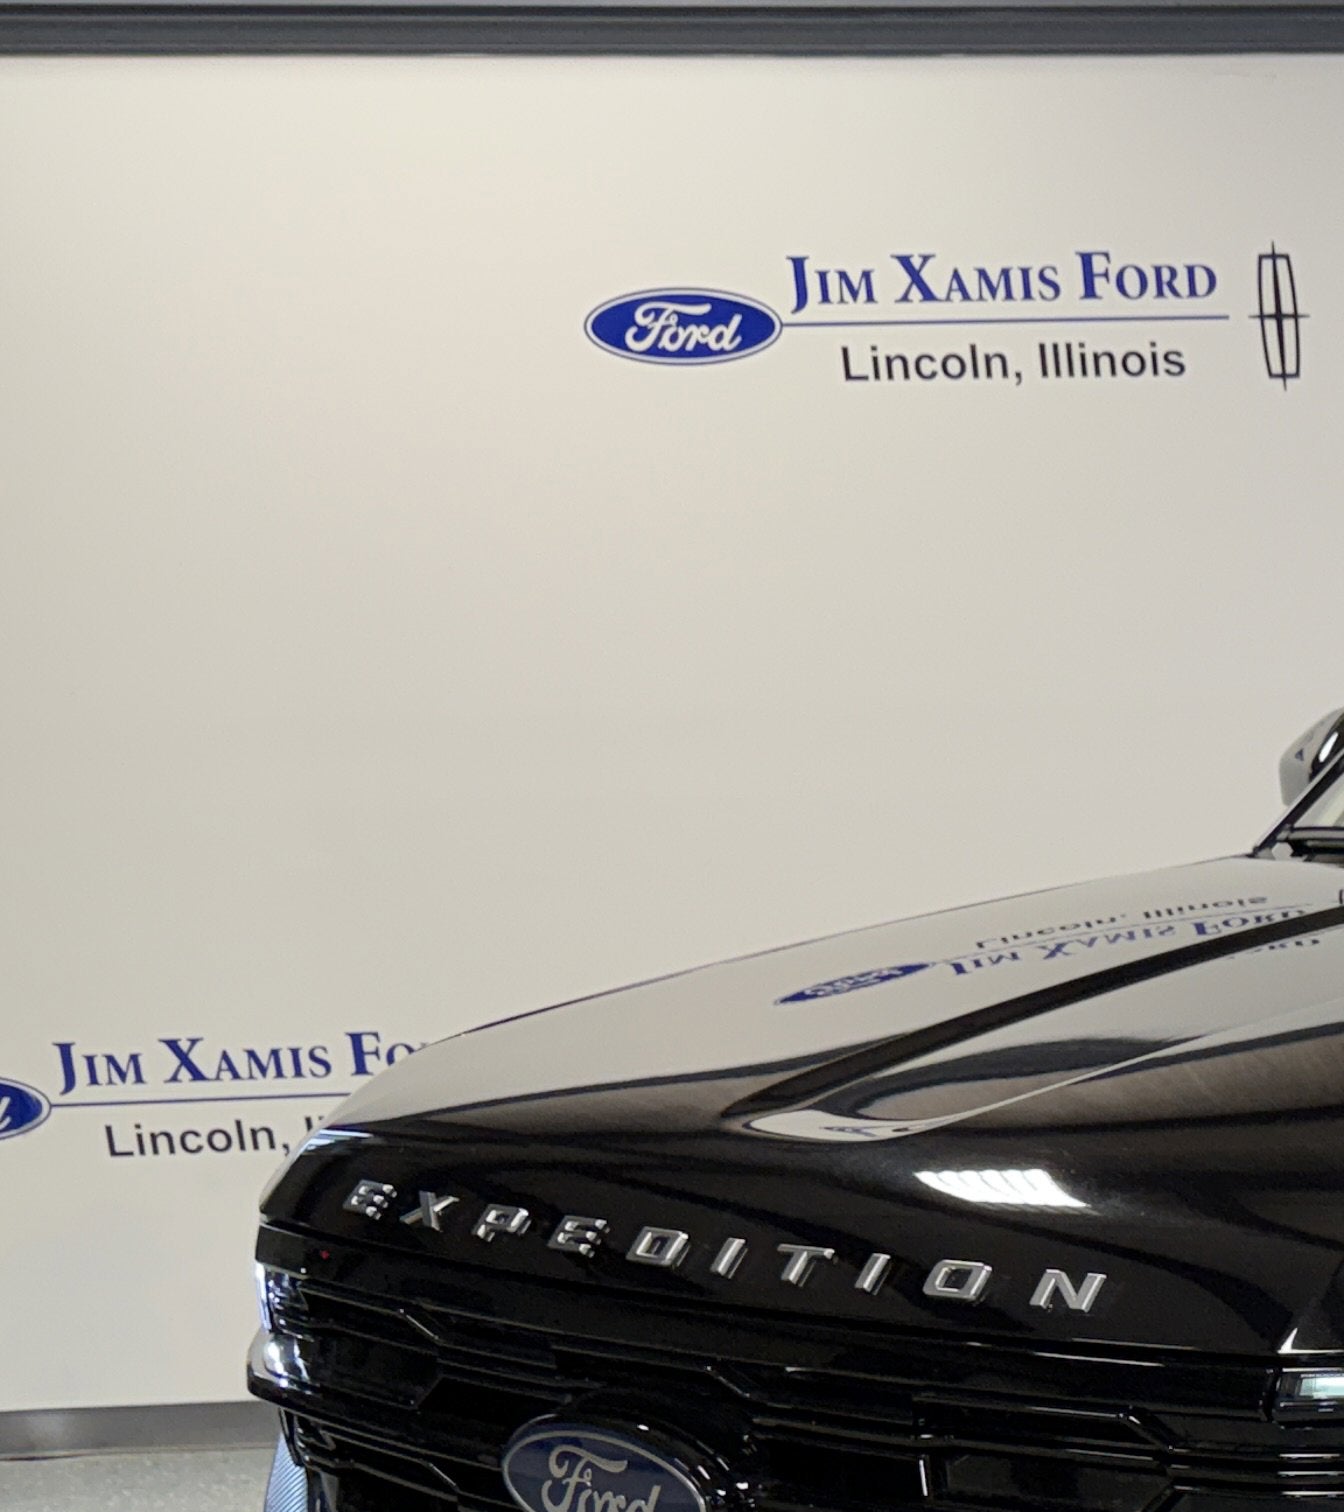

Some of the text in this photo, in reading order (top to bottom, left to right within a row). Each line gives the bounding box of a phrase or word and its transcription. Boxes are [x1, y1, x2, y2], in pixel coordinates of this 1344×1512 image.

[785, 250, 1218, 314] JIM XAMIS FORD
[840, 341, 1186, 387] Lincoln, Illinois
[52, 1041, 147, 1096] JIM
[157, 1036, 333, 1084] XAMIS
[105, 1119, 291, 1158] Lincoln,
[343, 1178, 1108, 1314] EXPEDITION
